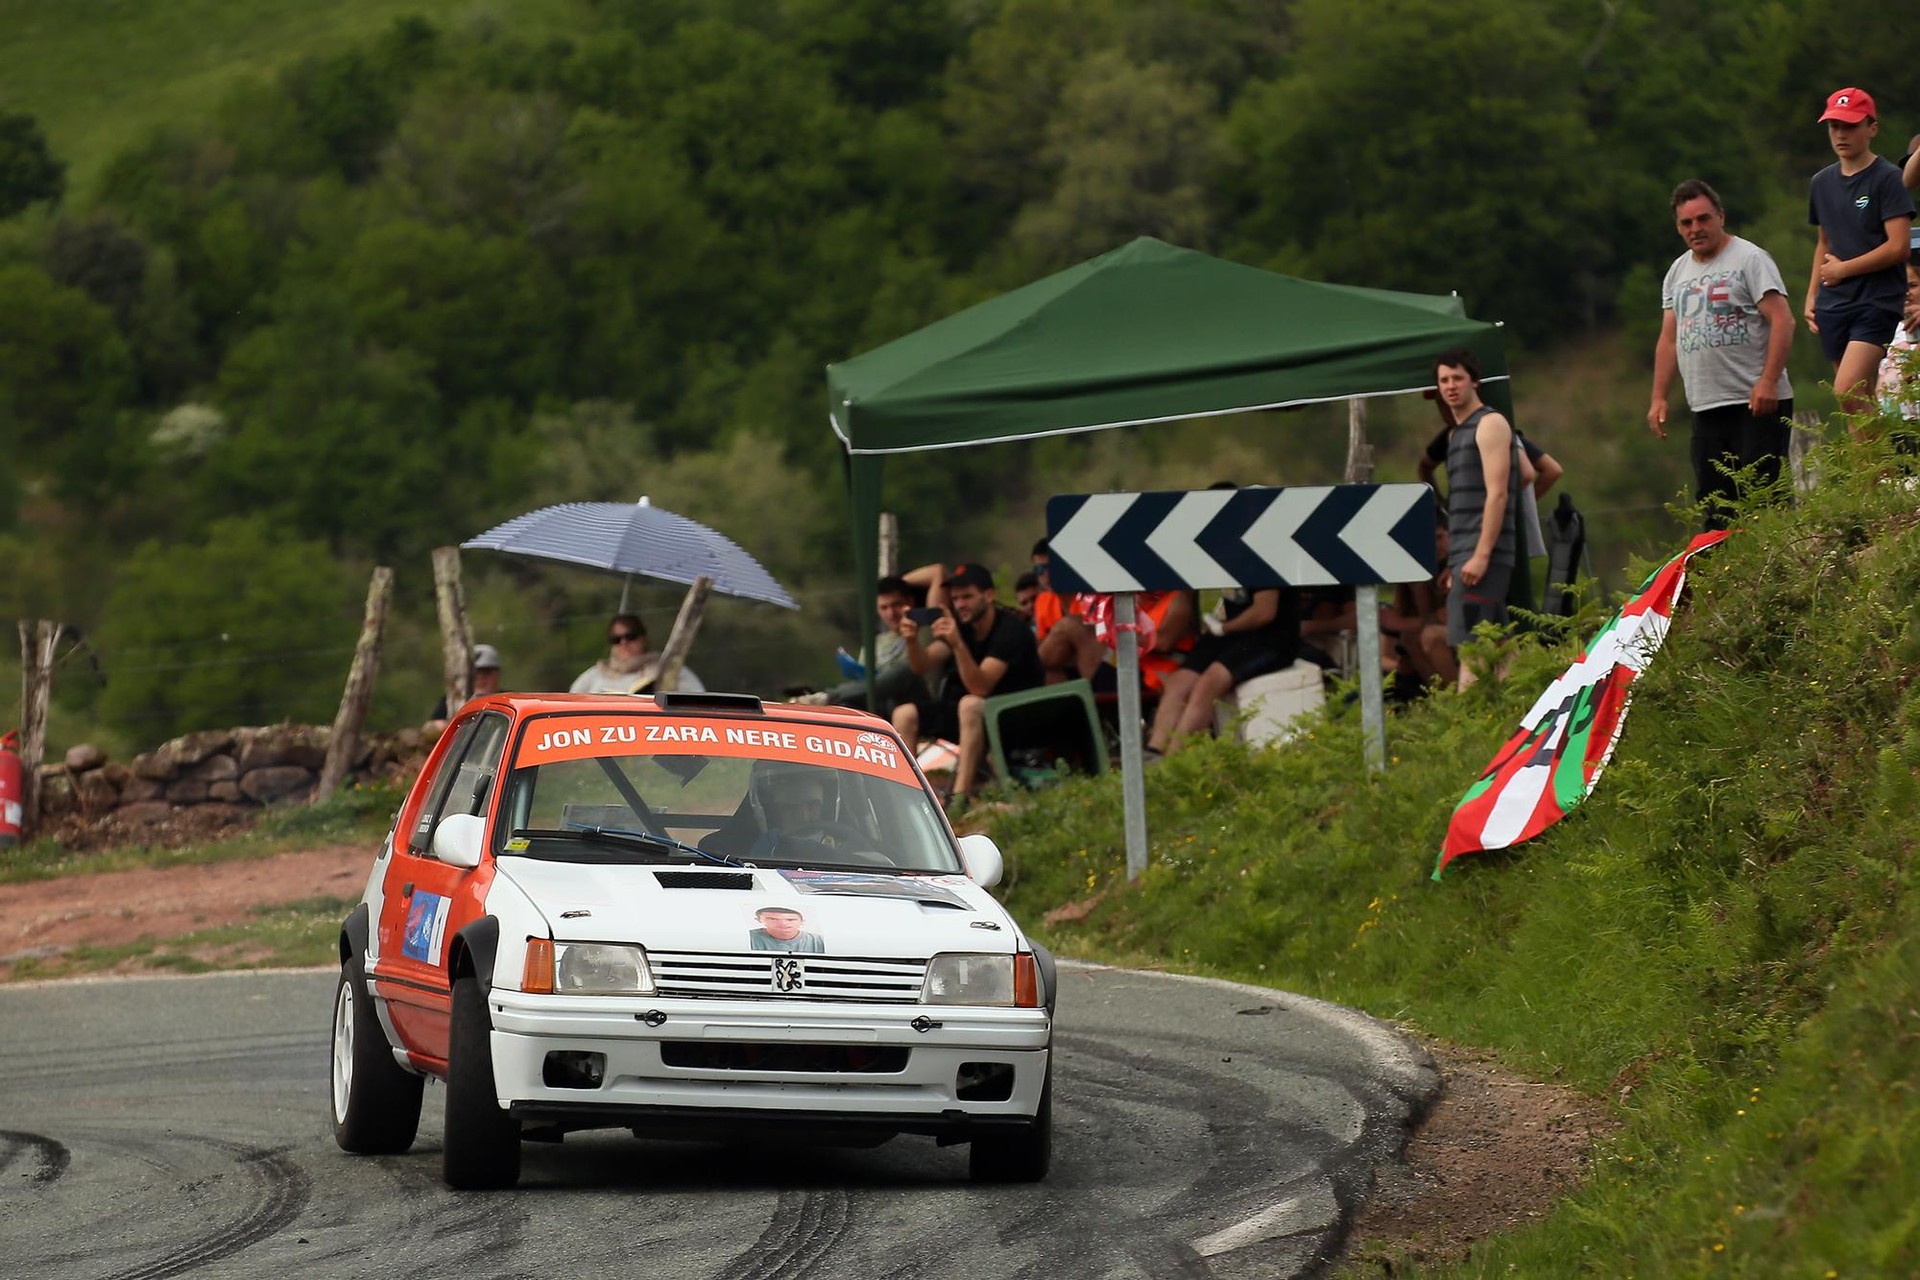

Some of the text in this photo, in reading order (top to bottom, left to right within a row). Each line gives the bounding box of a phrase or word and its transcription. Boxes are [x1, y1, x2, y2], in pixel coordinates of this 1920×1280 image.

[537, 726, 898, 769] JON ZU ZARA NERE GIDARI
